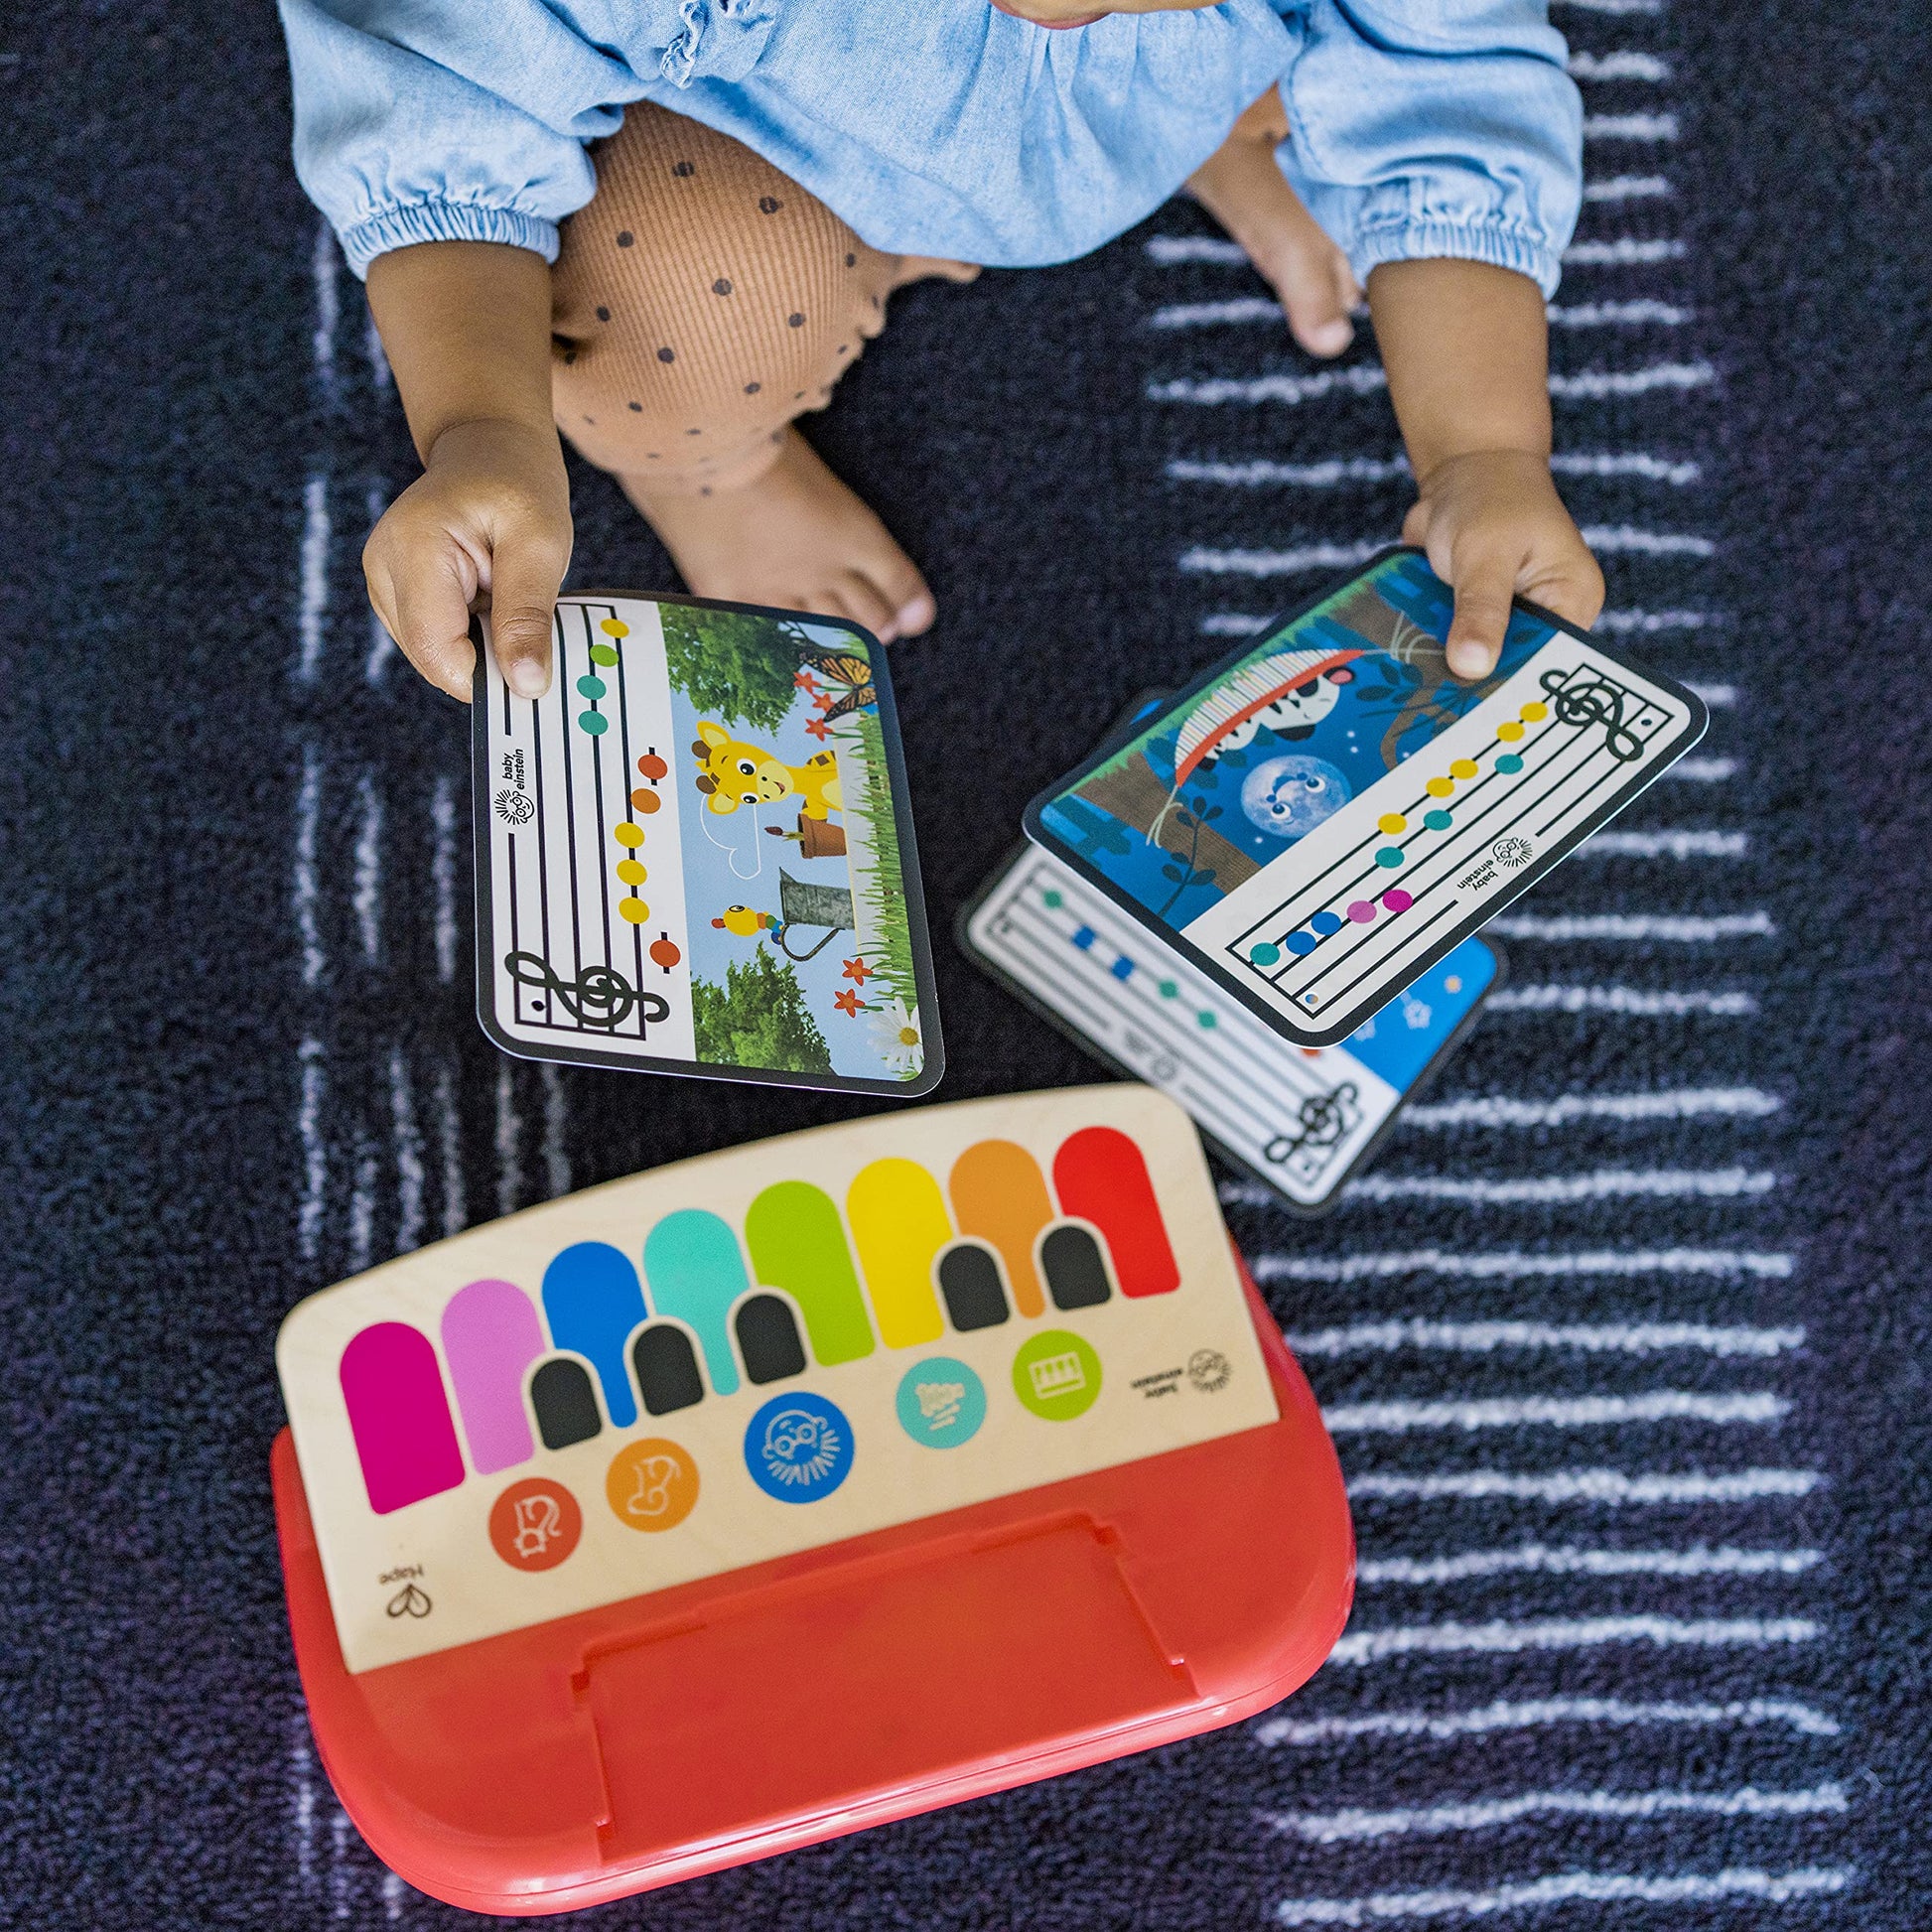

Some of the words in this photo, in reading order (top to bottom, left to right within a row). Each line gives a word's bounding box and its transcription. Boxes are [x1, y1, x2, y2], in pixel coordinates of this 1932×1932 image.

[502, 753, 514, 780] baby
[513, 749, 525, 790] einstein
[1456, 859, 1494, 890] einstein
[1471, 871, 1499, 891] baby
